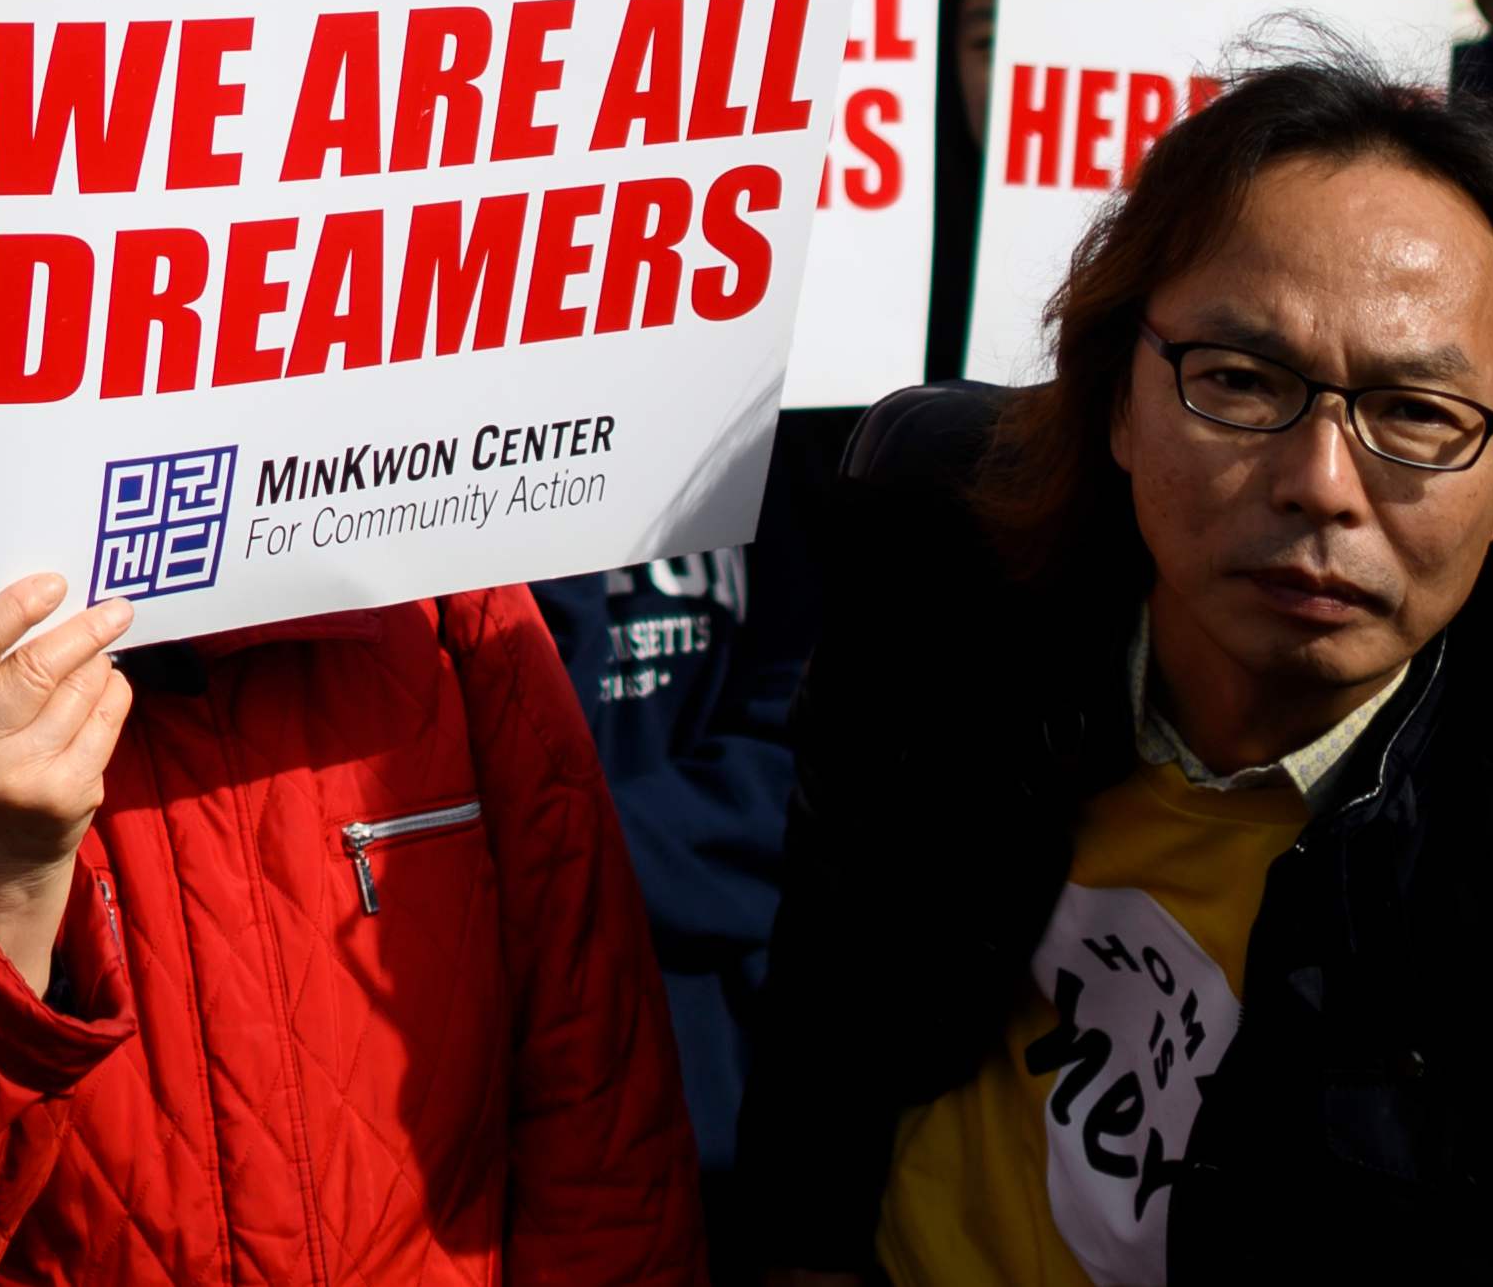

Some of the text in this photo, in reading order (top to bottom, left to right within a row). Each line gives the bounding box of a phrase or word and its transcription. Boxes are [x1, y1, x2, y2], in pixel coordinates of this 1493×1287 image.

[245, 467, 607, 560] For Community Action
